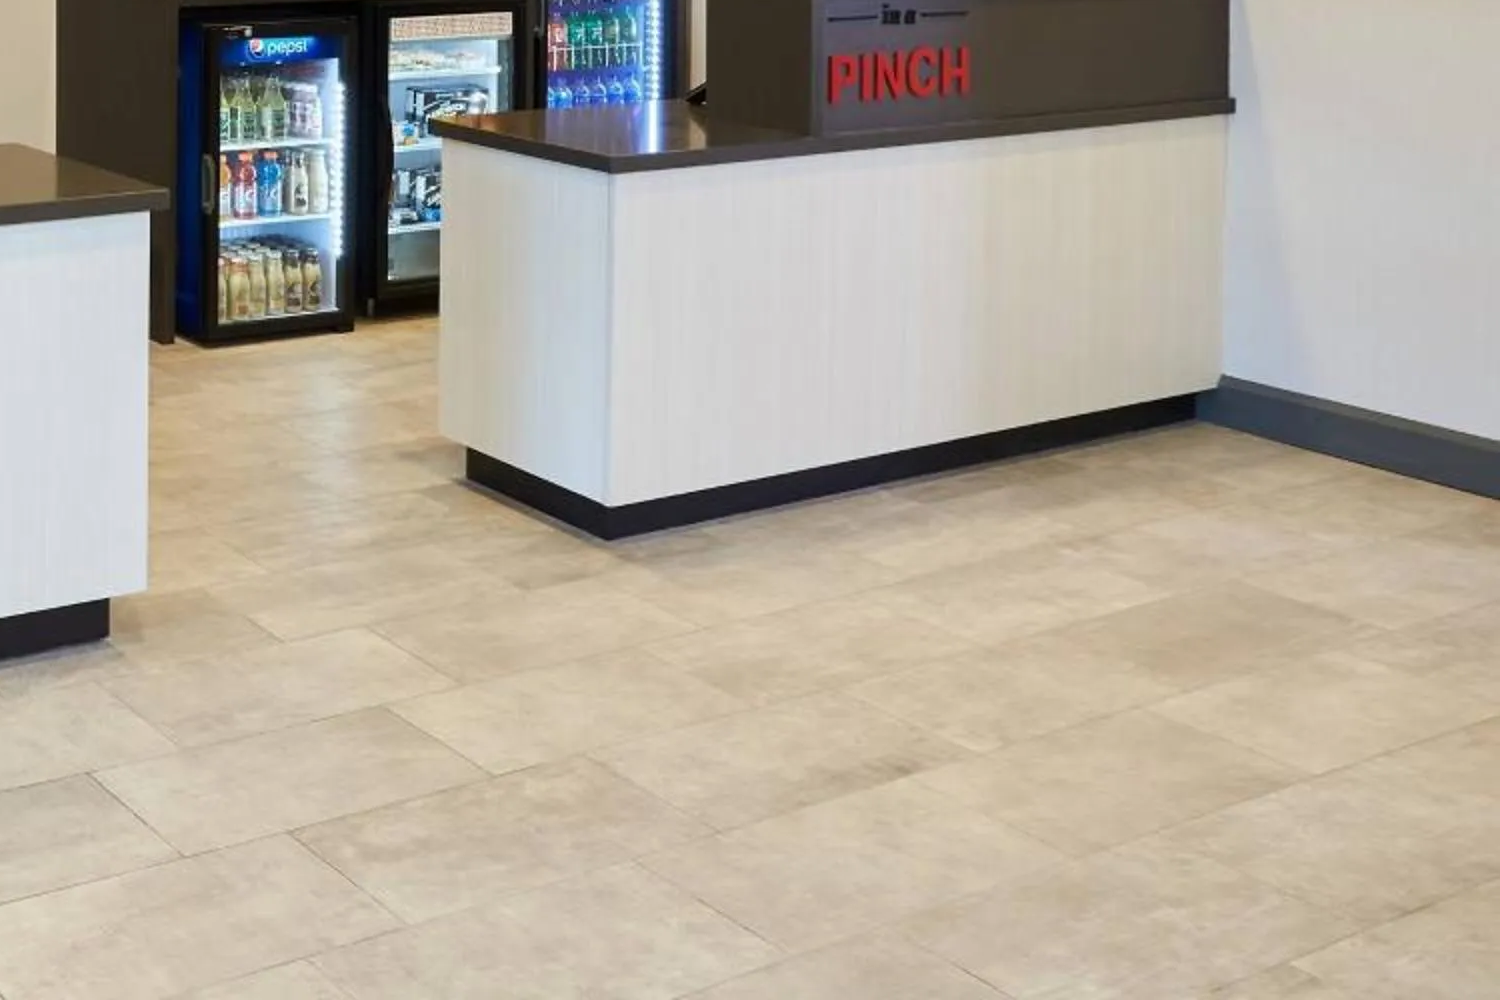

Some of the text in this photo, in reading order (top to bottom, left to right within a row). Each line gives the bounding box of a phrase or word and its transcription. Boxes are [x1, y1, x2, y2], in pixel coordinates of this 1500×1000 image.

[881, 3, 916, 25] in a
[267, 40, 308, 57] pepsi
[826, 45, 972, 106] PINCH
